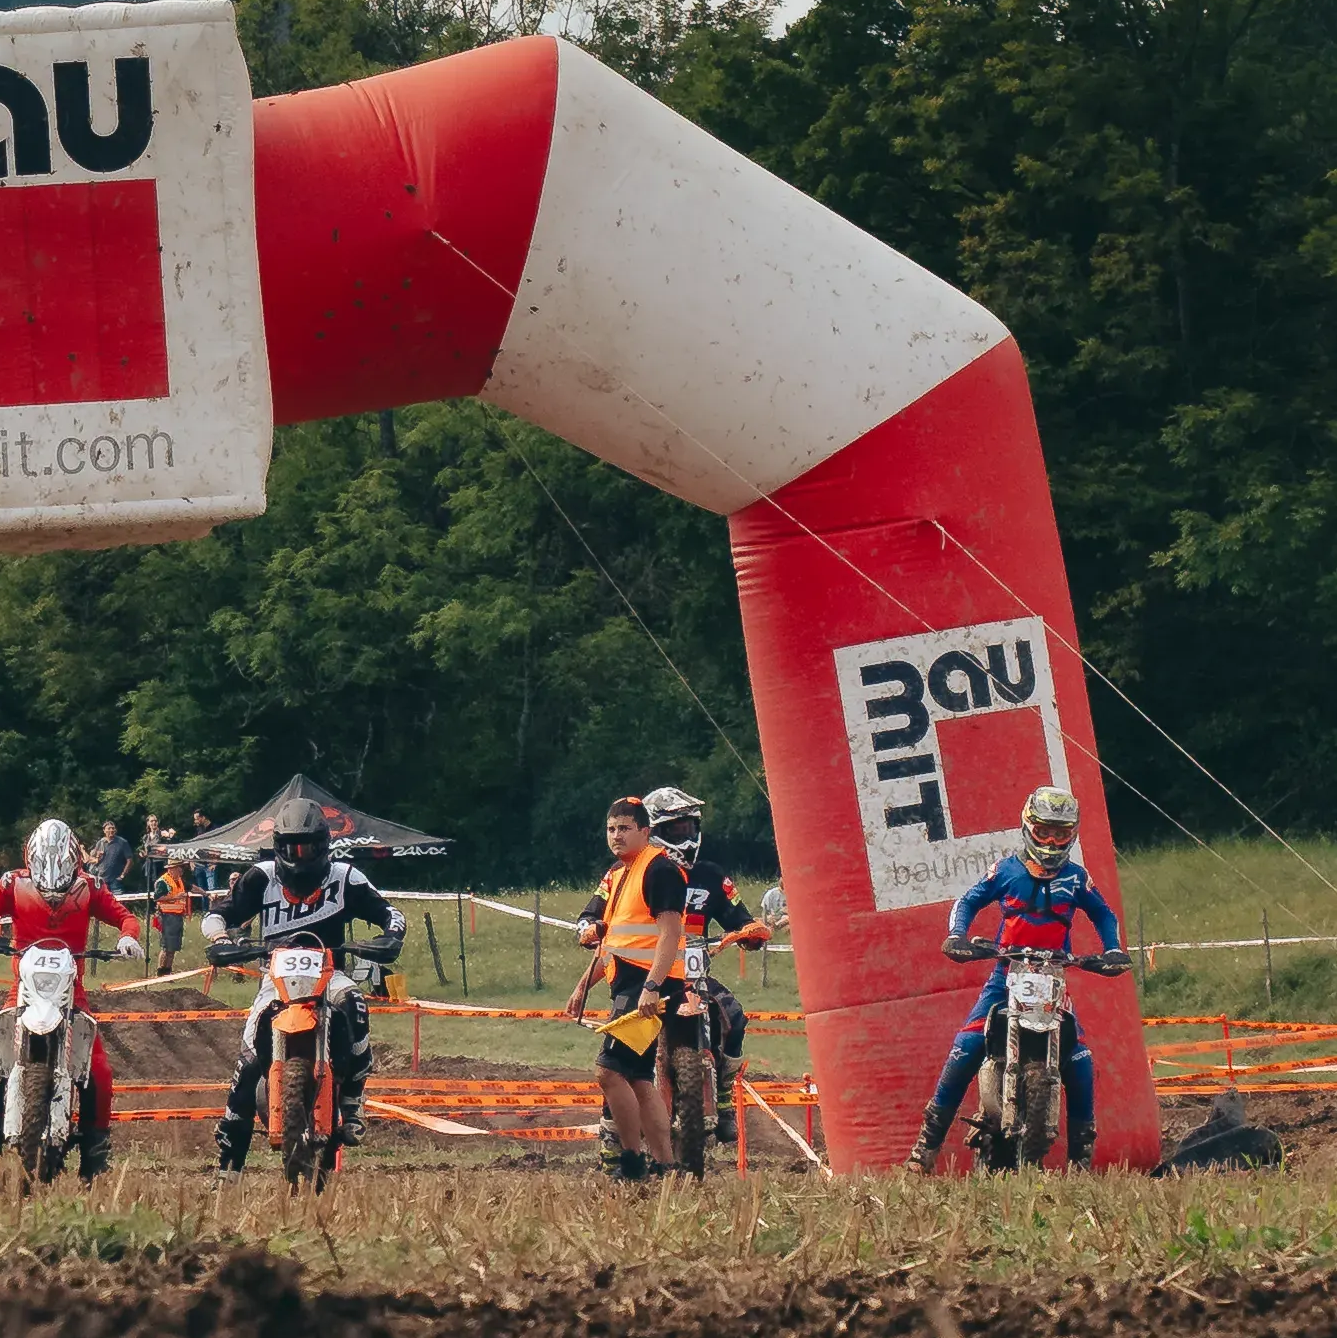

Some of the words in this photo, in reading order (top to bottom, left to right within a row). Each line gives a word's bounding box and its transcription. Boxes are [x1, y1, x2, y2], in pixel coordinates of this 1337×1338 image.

[34, 956, 61, 969] 45
[283, 956, 312, 971] 39
[352, 991, 367, 1024] FOX
